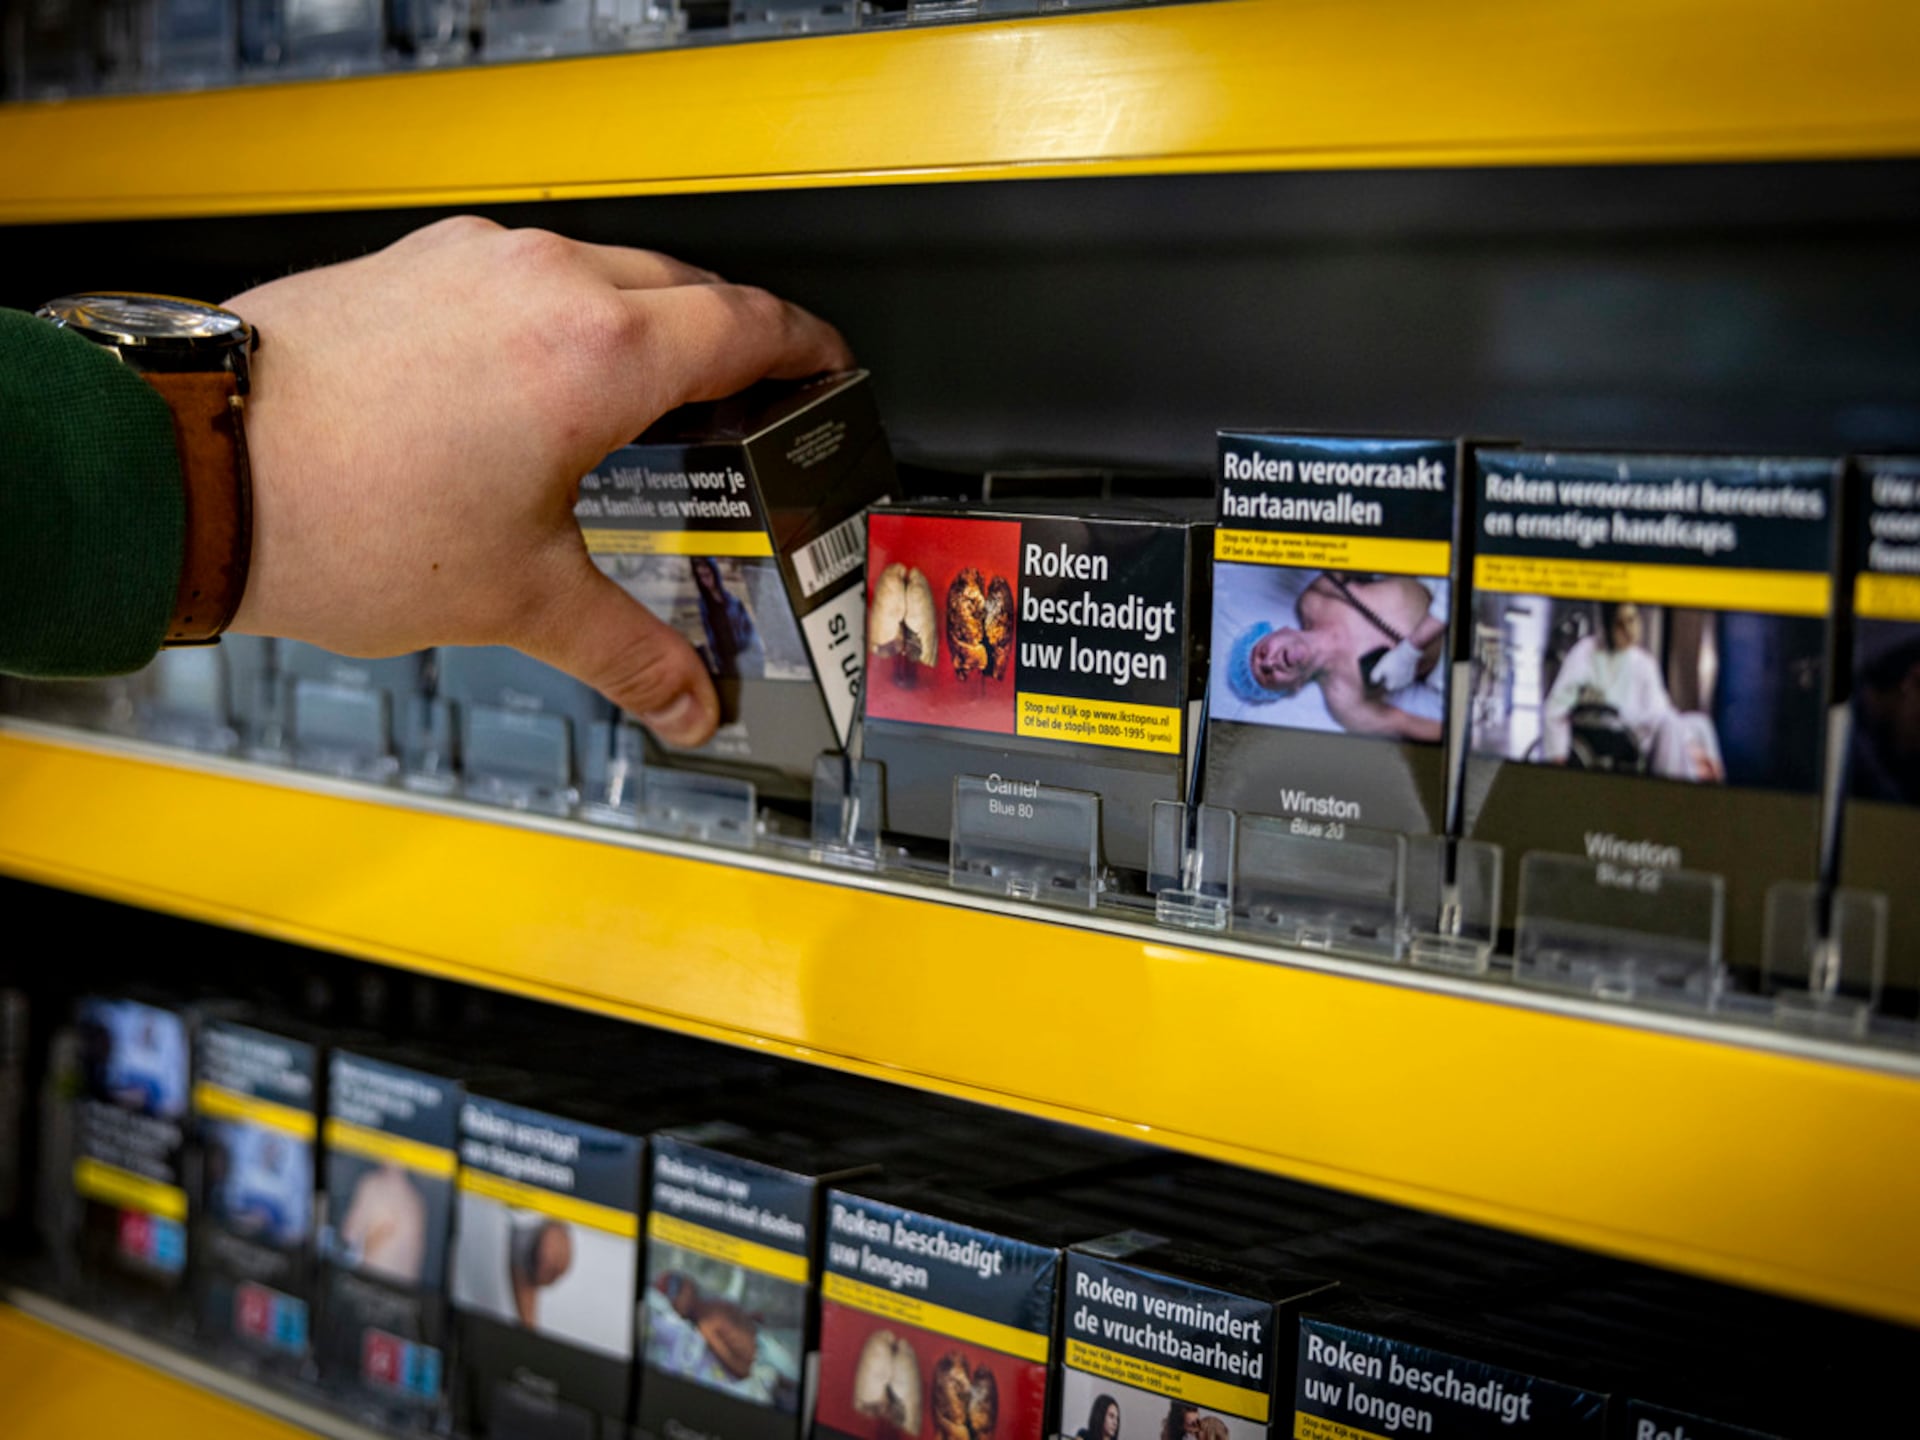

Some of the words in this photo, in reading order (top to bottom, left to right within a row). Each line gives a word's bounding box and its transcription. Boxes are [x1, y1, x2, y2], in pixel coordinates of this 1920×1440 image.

[611, 467, 644, 493] blijf
[644, 467, 689, 490] leven
[689, 471, 726, 490] voor
[726, 466, 746, 494] je
[1224, 451, 1293, 482] Roken
[1298, 456, 1446, 491] veroorzaakt
[602, 496, 656, 518] familie
[658, 501, 679, 518] en
[679, 496, 752, 518] vrienden
[1222, 487, 1383, 526] hartaanvallen
[1485, 473, 1555, 504] Roken
[1559, 477, 1698, 513] veroorzaakt
[1701, 478, 1826, 520] beroertes
[1485, 513, 1513, 536] en
[1516, 510, 1609, 549] ernstige
[1611, 511, 1736, 556] handicaps
[1024, 543, 1109, 581] Roken
[1022, 587, 1176, 642] beschadigt
[1020, 641, 1063, 671] uw
[1069, 637, 1167, 685] longen
[1023, 715, 1036, 727] Of
[1036, 716, 1050, 728] bel
[1051, 718, 1062, 731] de
[1064, 721, 1097, 736] stoplijn
[1098, 724, 1146, 740] 0800-1995
[1024, 701, 1043, 714] Stop
[1045, 703, 1059, 714] nu!
[1062, 704, 1078, 718] Kijk
[1080, 709, 1092, 721] op
[1093, 709, 1170, 727] www.ikstopnu.nl
[989, 799, 1016, 817] Blue
[1018, 803, 1034, 819] 80
[1280, 788, 1361, 820] Winston
[1290, 817, 1322, 838] Blue
[1584, 830, 1682, 868] Winston
[656, 1153, 698, 1184] Roken
[831, 1203, 891, 1245] Roken
[893, 1218, 1002, 1280] beschadigt
[830, 1240, 859, 1270] uw
[861, 1241, 928, 1291] longen
[1075, 1271, 1137, 1313] Roken
[1142, 1295, 1262, 1346] vermindert
[1073, 1305, 1100, 1337] de
[1102, 1316, 1264, 1382] vruchtbaarheid
[1306, 1333, 1382, 1381] Roken
[1388, 1347, 1532, 1425] beschadigt
[1303, 1375, 1343, 1408] uw
[1346, 1382, 1433, 1435] longen
